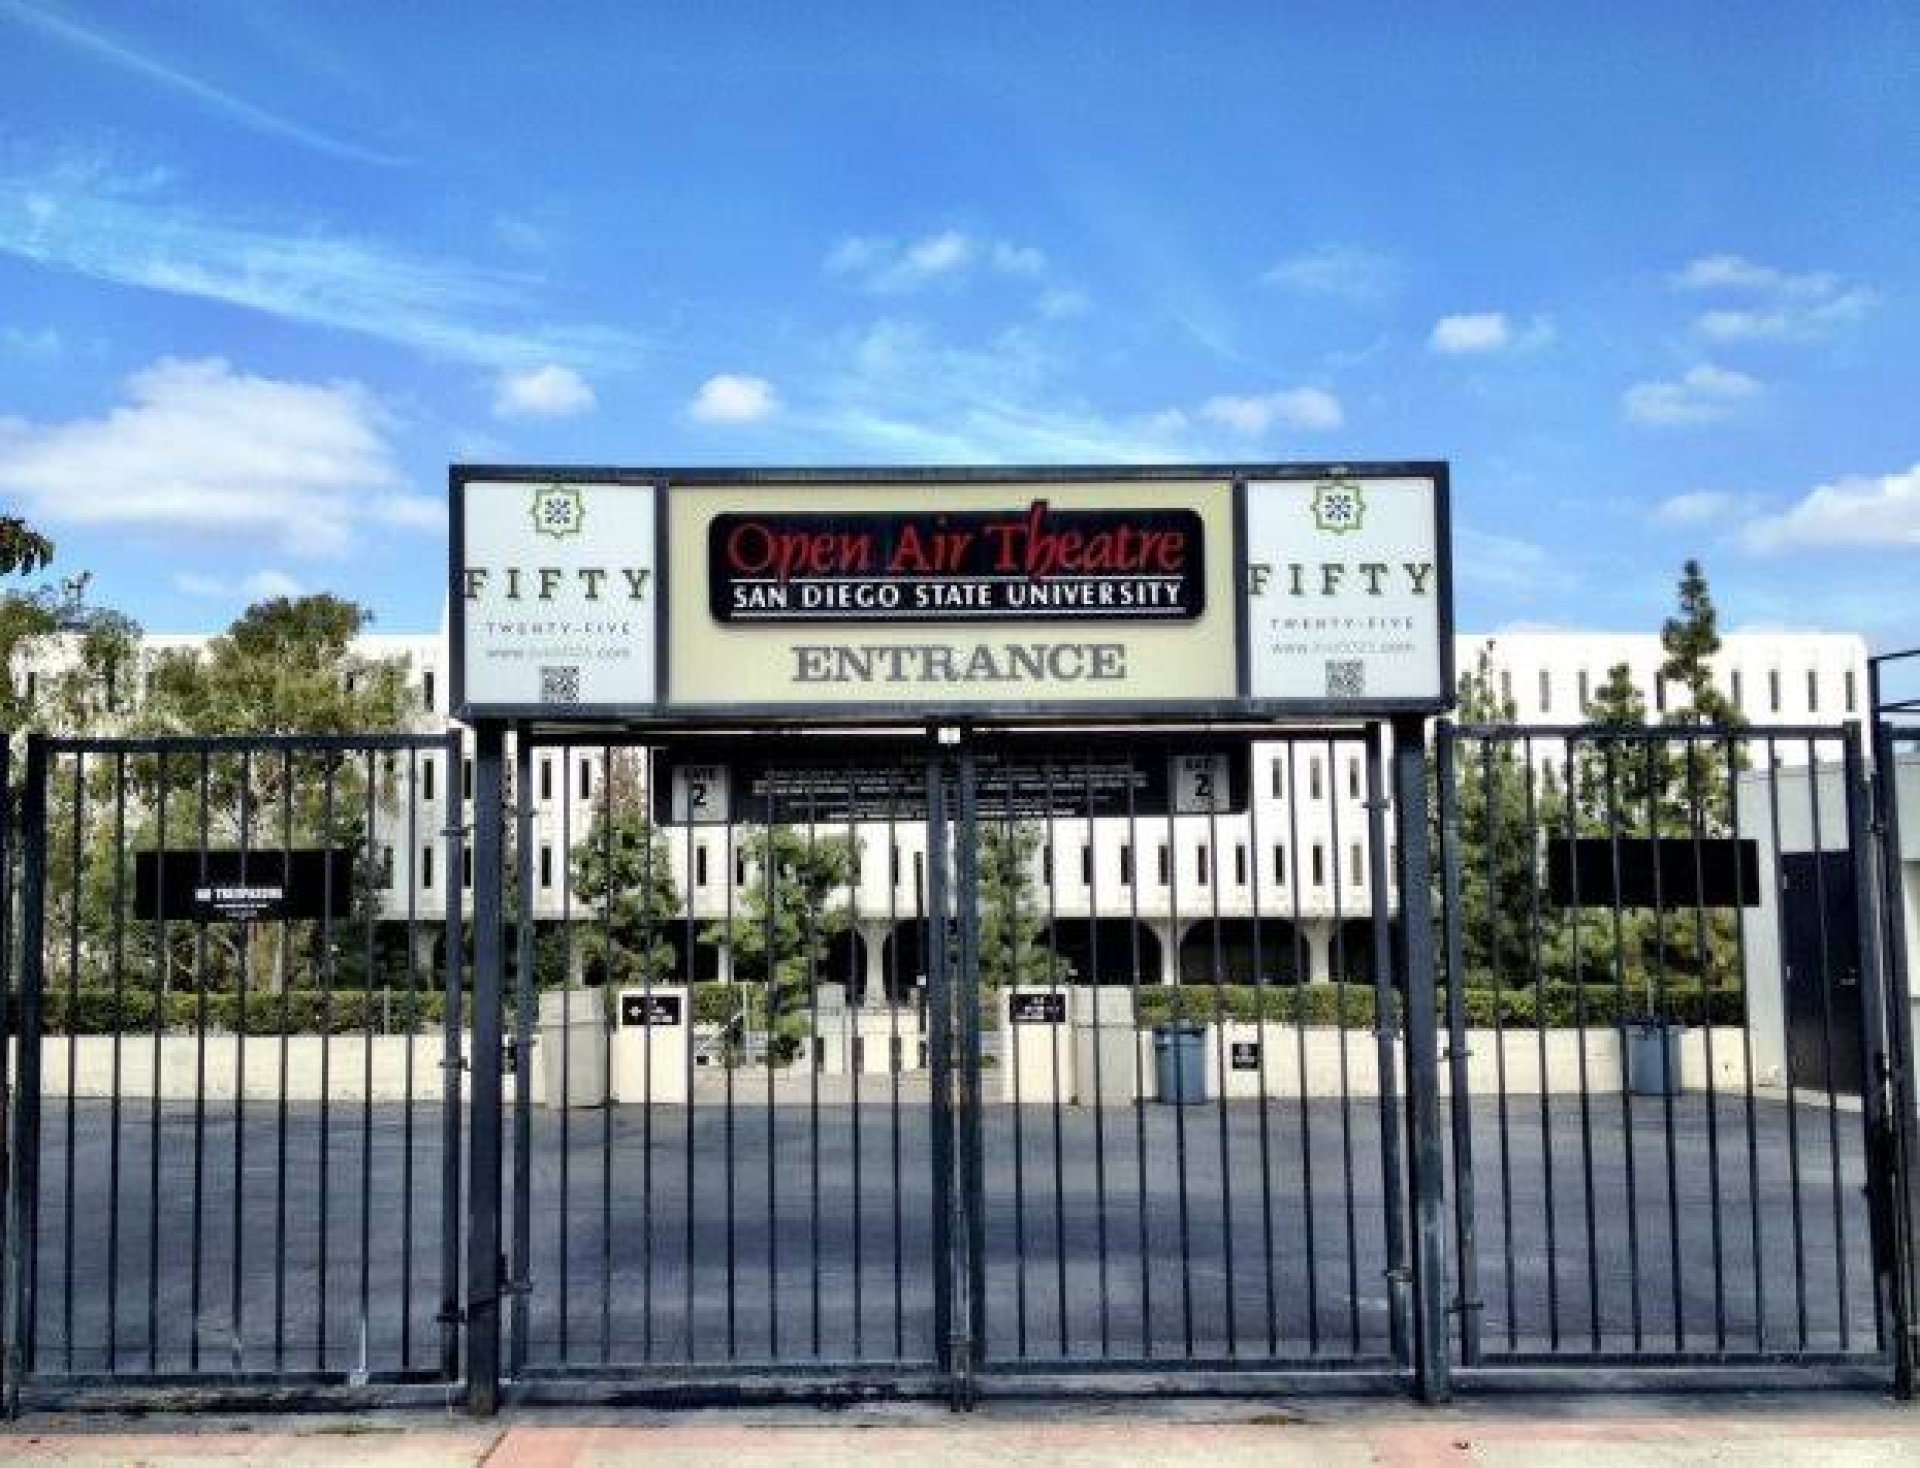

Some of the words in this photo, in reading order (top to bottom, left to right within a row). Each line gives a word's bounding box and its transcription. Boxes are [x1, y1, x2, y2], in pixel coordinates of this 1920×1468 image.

[728, 522, 870, 580] Open
[886, 516, 977, 572] Air
[983, 500, 1186, 580] Theatre
[463, 566, 651, 600] FIFTY
[733, 584, 788, 608] SAN
[801, 583, 899, 608] DIEGO
[916, 583, 992, 607] STATE
[1008, 581, 1181, 606] UNIVERSITY
[1247, 563, 1432, 596] FIFTY
[791, 642, 1128, 683] ENTRANCE
[693, 783, 707, 806] 2
[1194, 773, 1211, 797] 2
